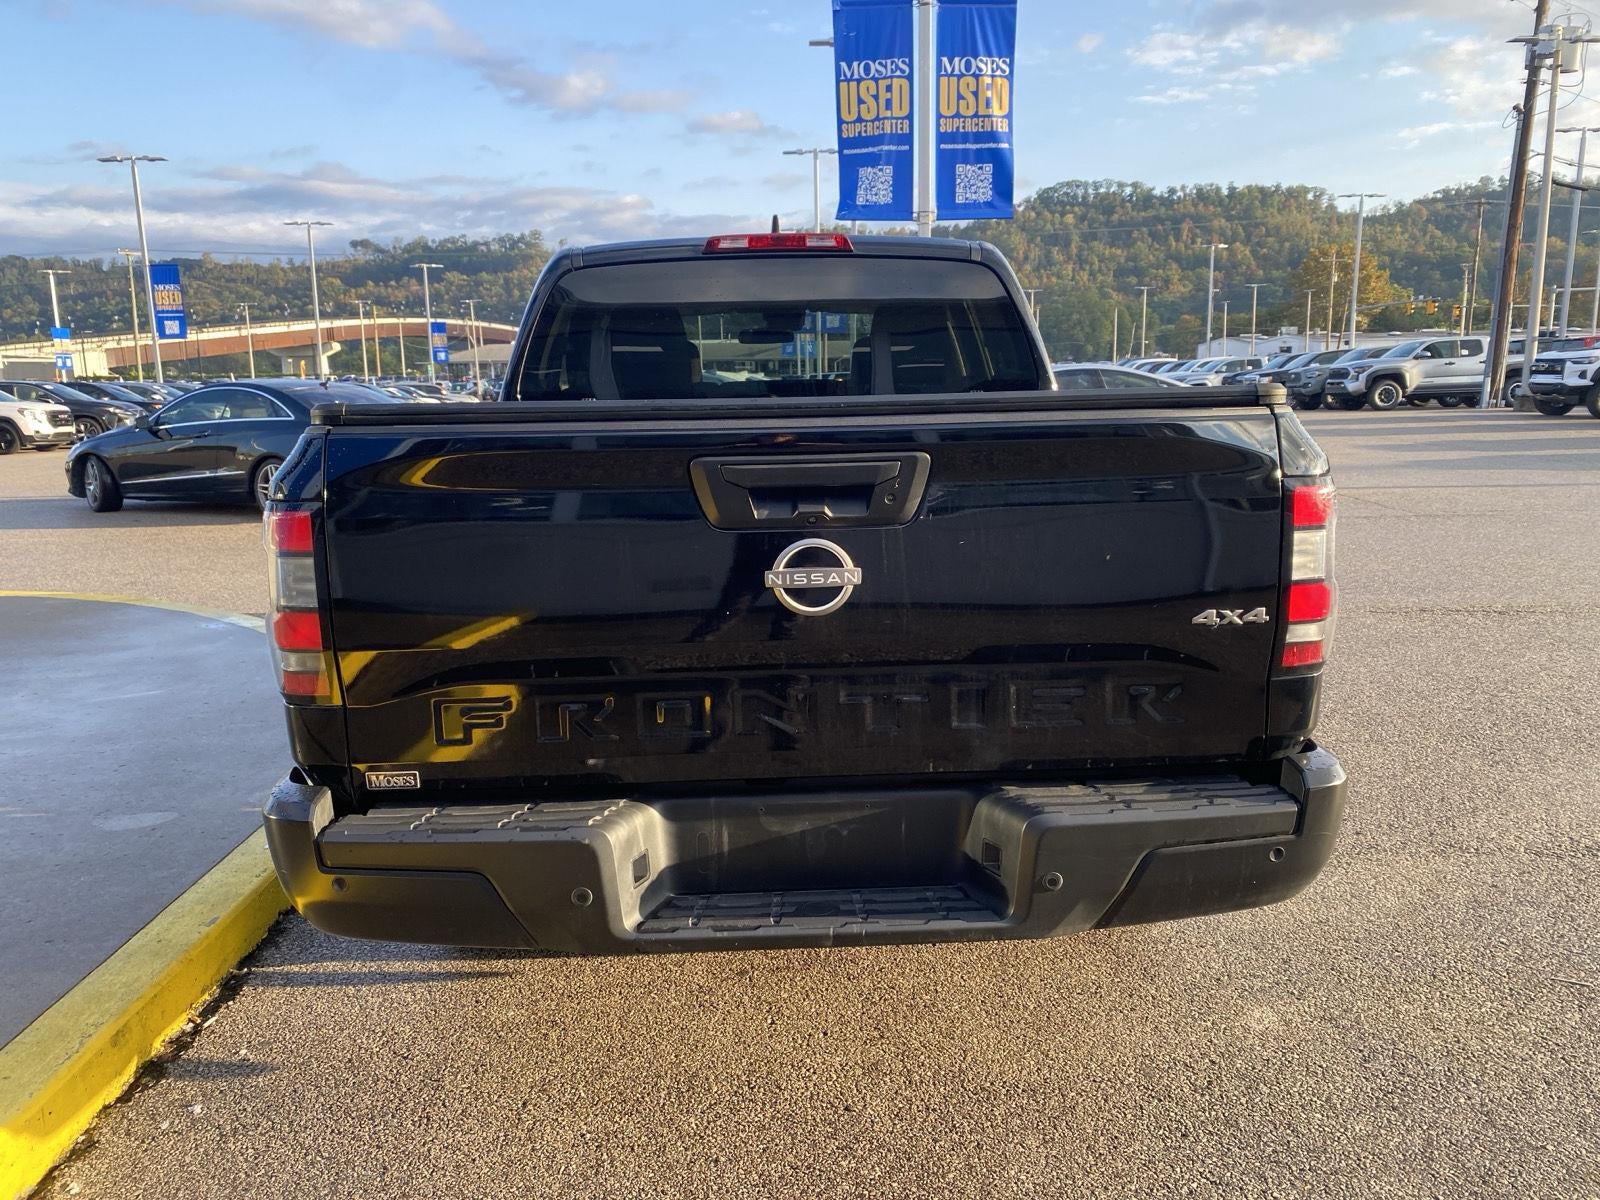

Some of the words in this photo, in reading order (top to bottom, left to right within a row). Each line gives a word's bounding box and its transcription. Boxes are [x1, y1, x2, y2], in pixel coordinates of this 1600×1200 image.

[839, 57, 910, 80] MOSES
[940, 56, 1010, 76] MOSES
[839, 77, 910, 122] USED
[939, 75, 1010, 117] USED
[841, 119, 910, 138] SUPERCENTER
[939, 117, 1009, 133] SUPERCENTER
[155, 290, 182, 305] USED
[768, 571, 858, 585] NISSAN
[431, 680, 1187, 746] FRONTIER
